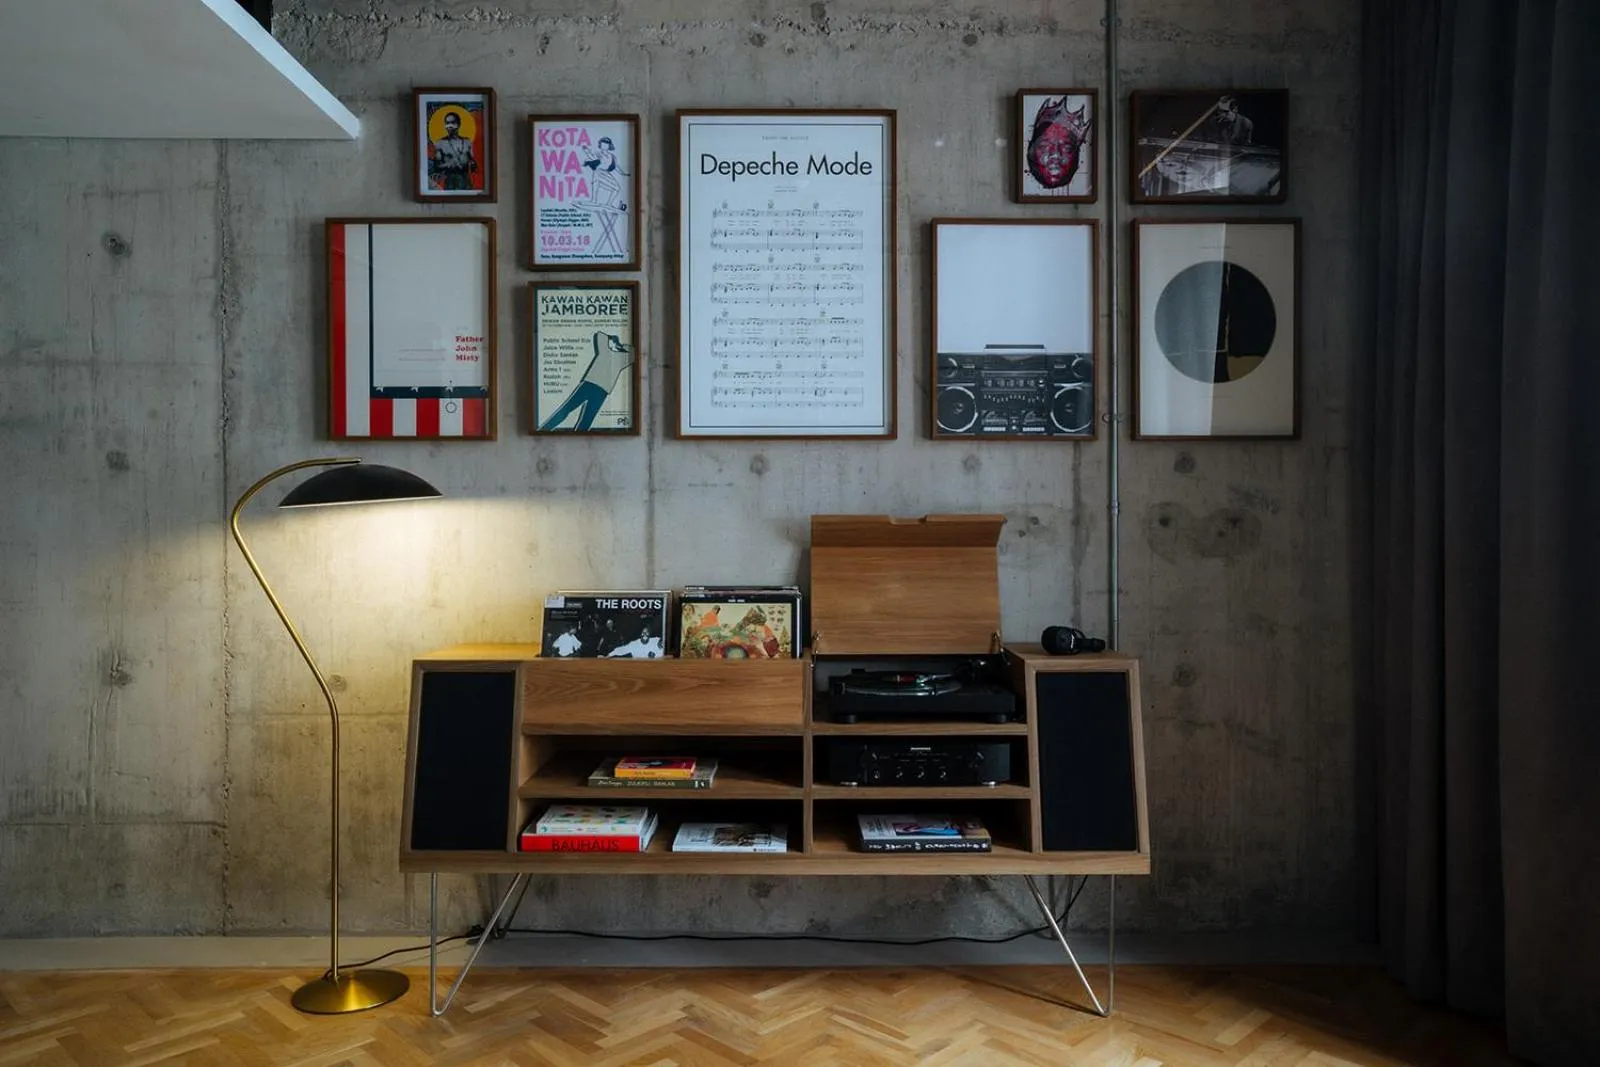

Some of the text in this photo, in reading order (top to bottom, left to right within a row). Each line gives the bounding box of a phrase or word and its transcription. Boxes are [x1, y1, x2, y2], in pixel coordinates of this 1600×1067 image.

[538, 127, 592, 148] KOTA
[541, 150, 582, 174] WA
[700, 150, 873, 183] Depeche Mode
[539, 175, 590, 201] NITA
[541, 234, 591, 246] 10.03.18
[541, 295, 628, 303] KAWAN KAWAN
[541, 303, 628, 316] JAMBOREE
[455, 335, 485, 343] Father
[455, 354, 480, 362] Misty
[595, 598, 619, 609] THE
[621, 598, 662, 610] ROOTS
[551, 838, 620, 852] BAUHAUS
